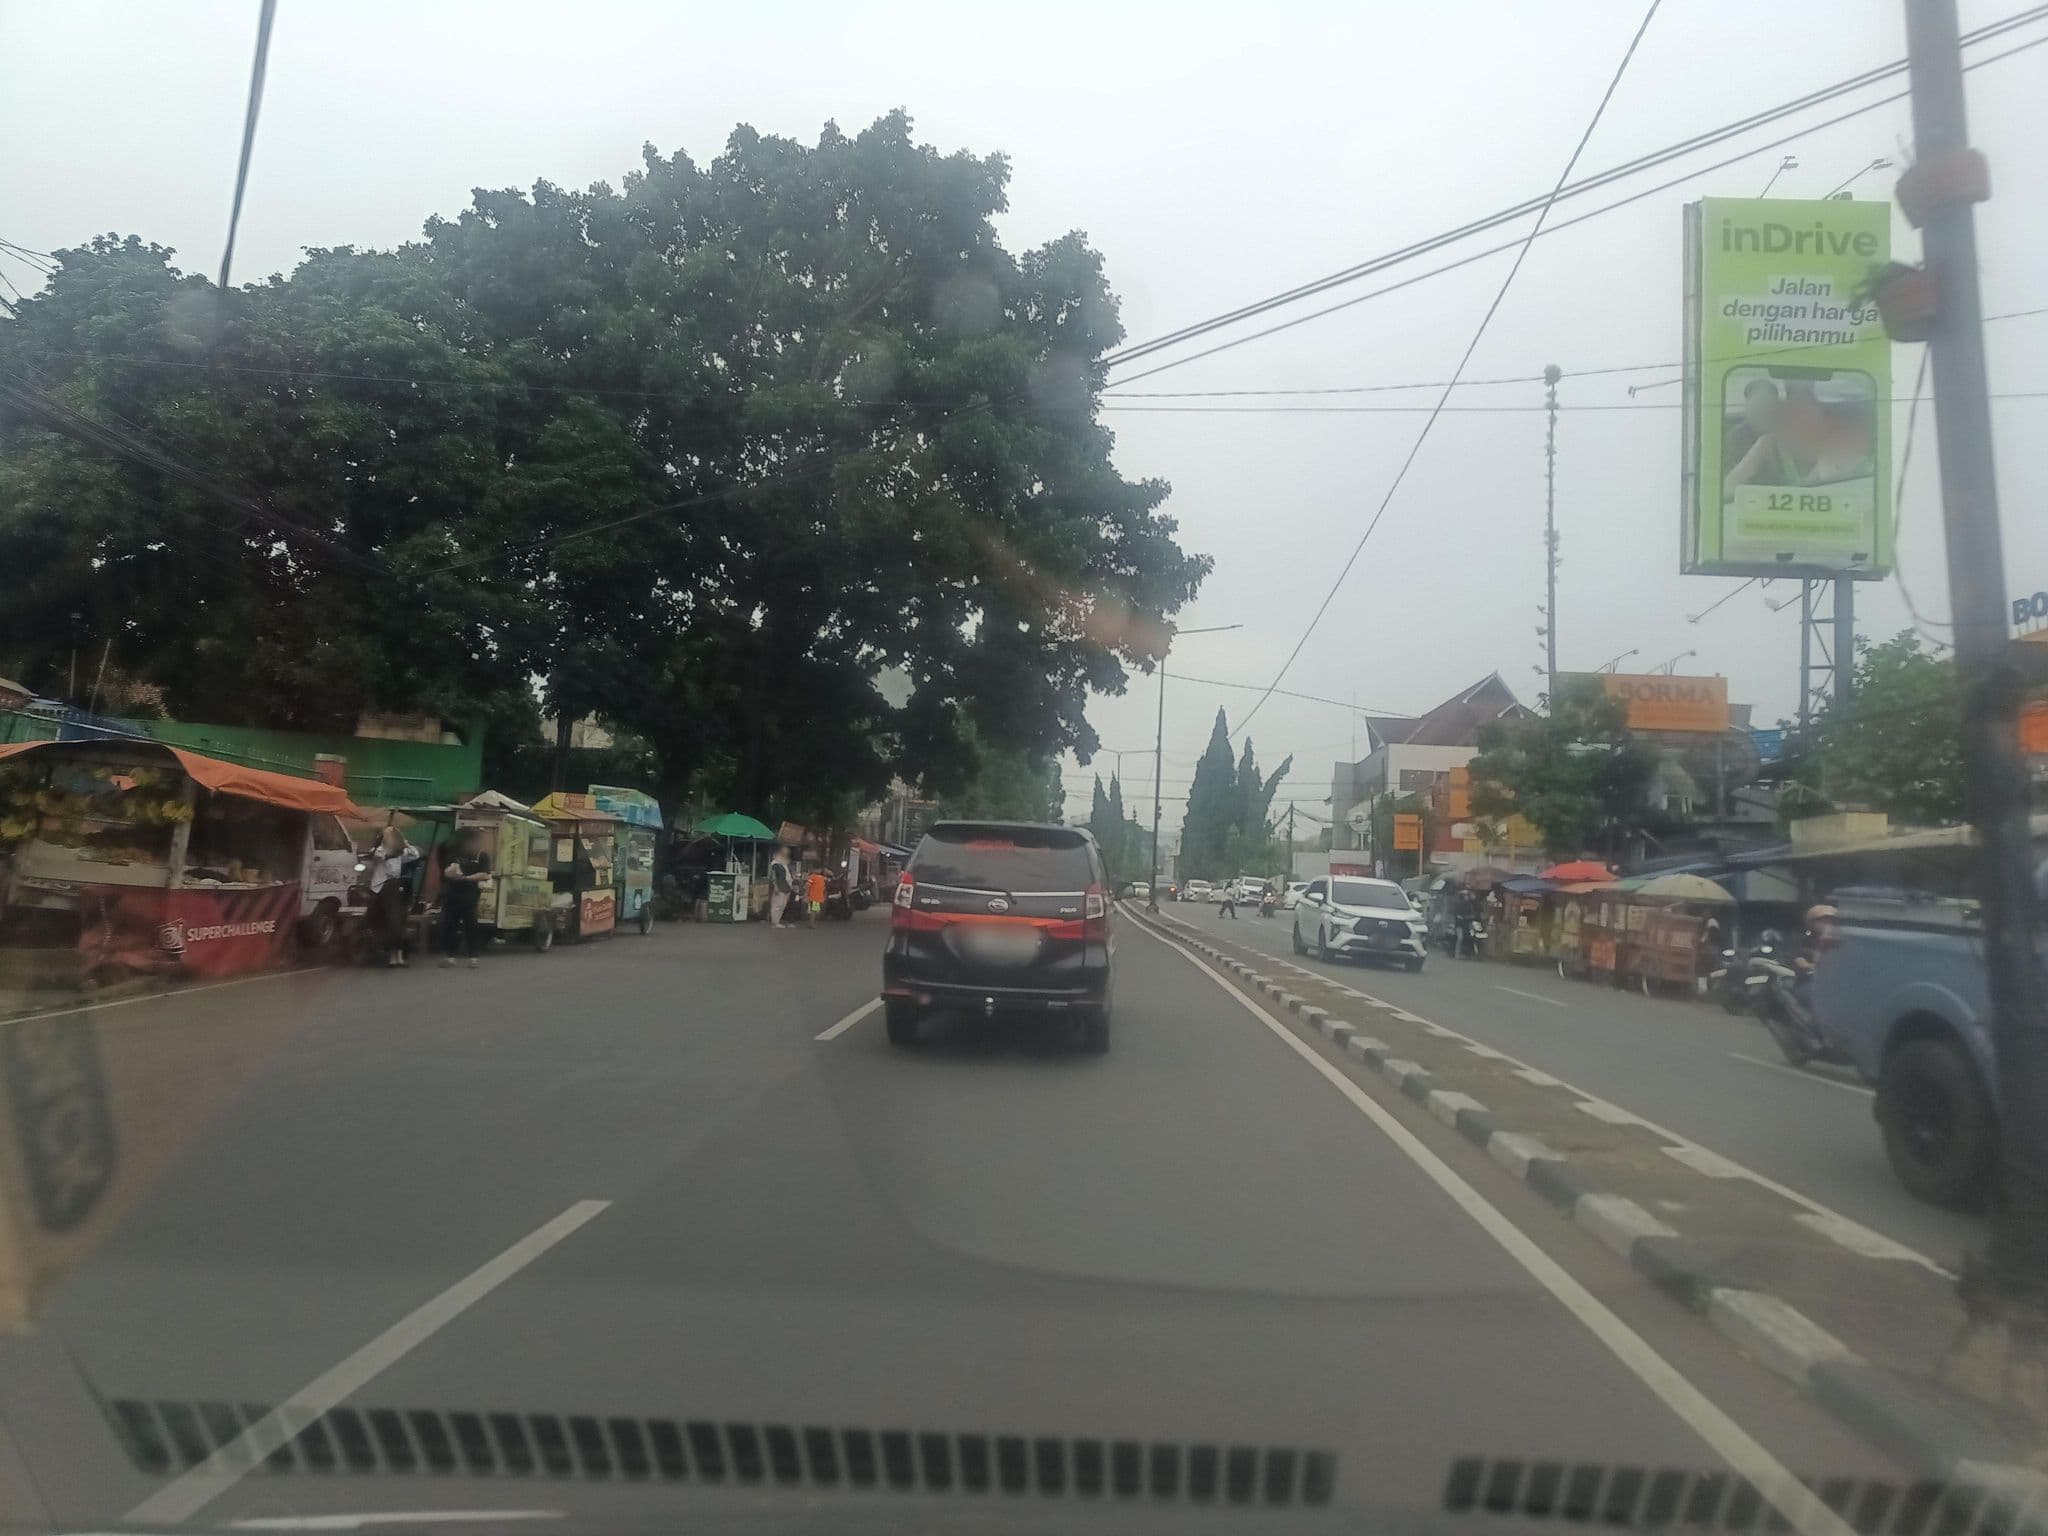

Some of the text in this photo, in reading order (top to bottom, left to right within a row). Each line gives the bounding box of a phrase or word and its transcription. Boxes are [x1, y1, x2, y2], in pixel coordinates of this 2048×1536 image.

[1722, 218, 1878, 256] inDrive
[1771, 278, 1831, 296] Jalan
[1723, 299, 1879, 326] dengan harga
[1747, 324, 1855, 345] pilihanmu
[1767, 494, 1832, 512] 12 RB
[187, 920, 276, 942] SUPERCHALLENGE
